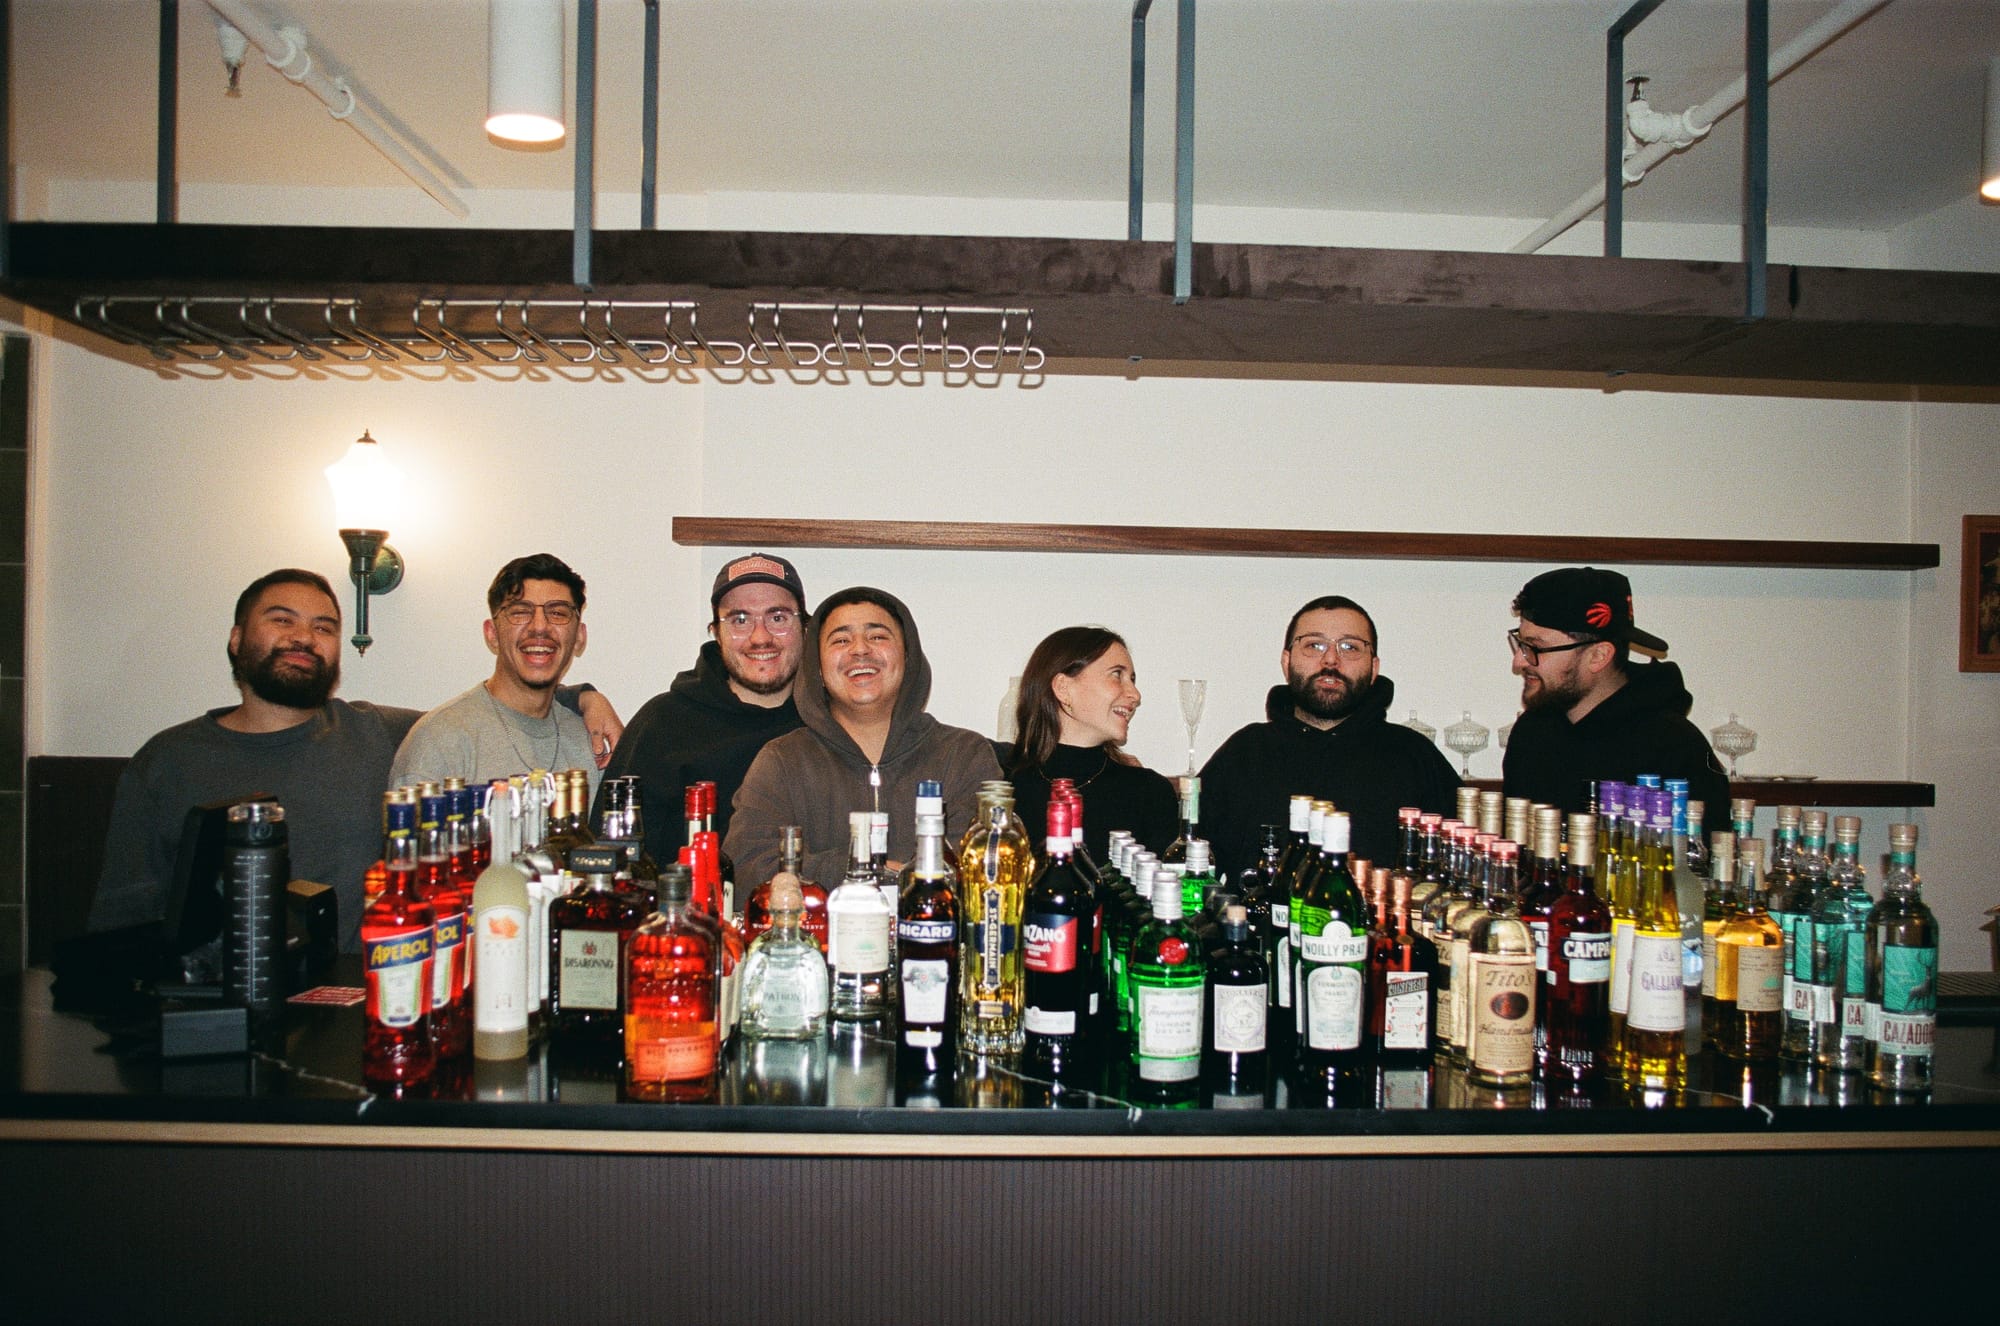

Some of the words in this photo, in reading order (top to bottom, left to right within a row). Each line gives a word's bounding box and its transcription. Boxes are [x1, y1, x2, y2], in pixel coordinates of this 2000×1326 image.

[899, 923, 953, 938] RICARD
[371, 938, 429, 966] APEROL
[1304, 942, 1340, 956] NOILLY
[1342, 942, 1366, 957] PRAT
[564, 957, 614, 969] DISARONNO
